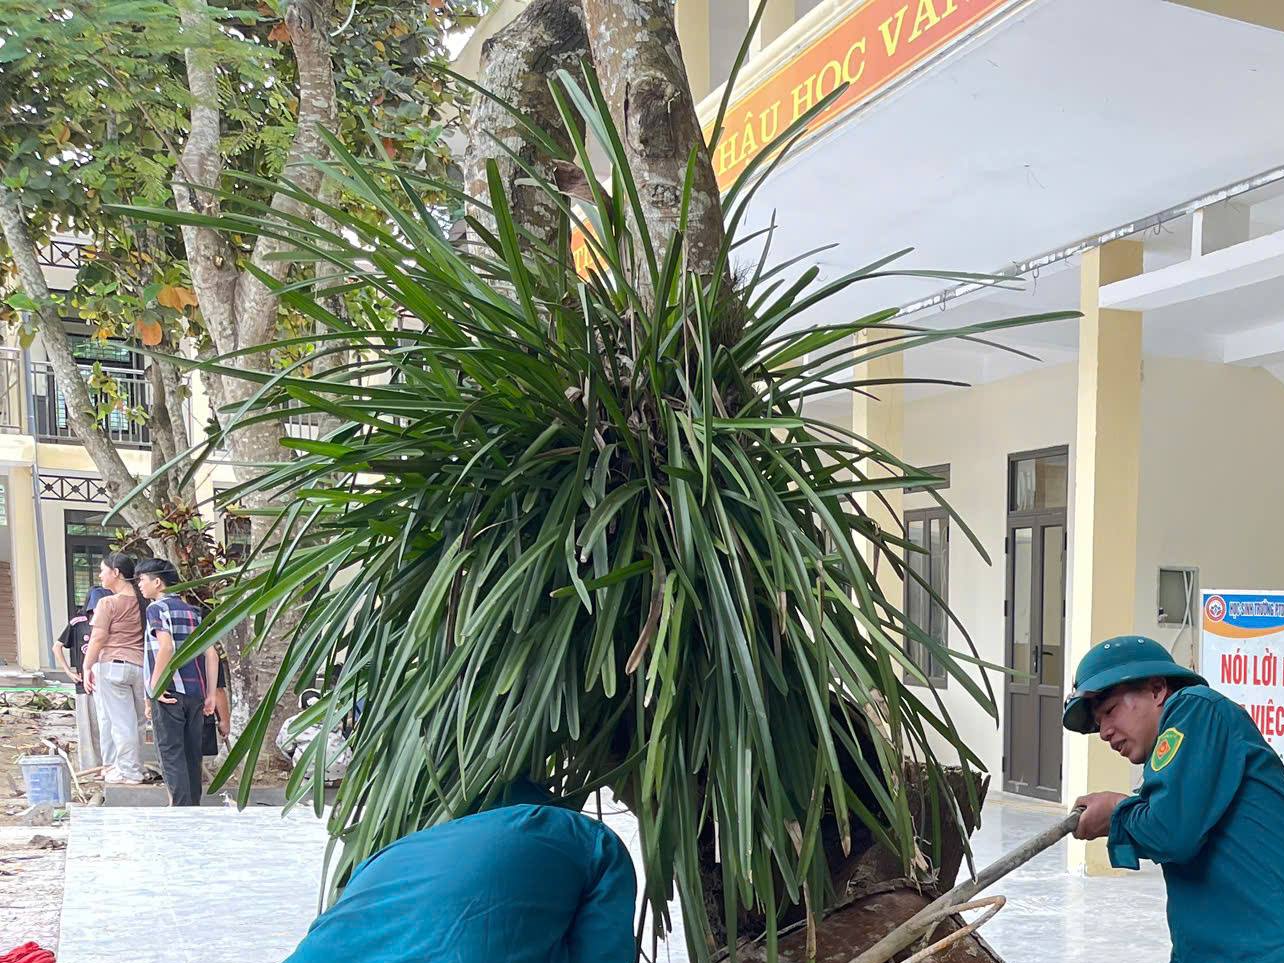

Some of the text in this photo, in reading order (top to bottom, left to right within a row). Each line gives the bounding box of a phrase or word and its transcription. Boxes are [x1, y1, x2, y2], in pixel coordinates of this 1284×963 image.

[790, 36, 867, 124] HỌC
[1220, 648, 1248, 686] NÓI
[1252, 648, 1278, 688] LỜI
